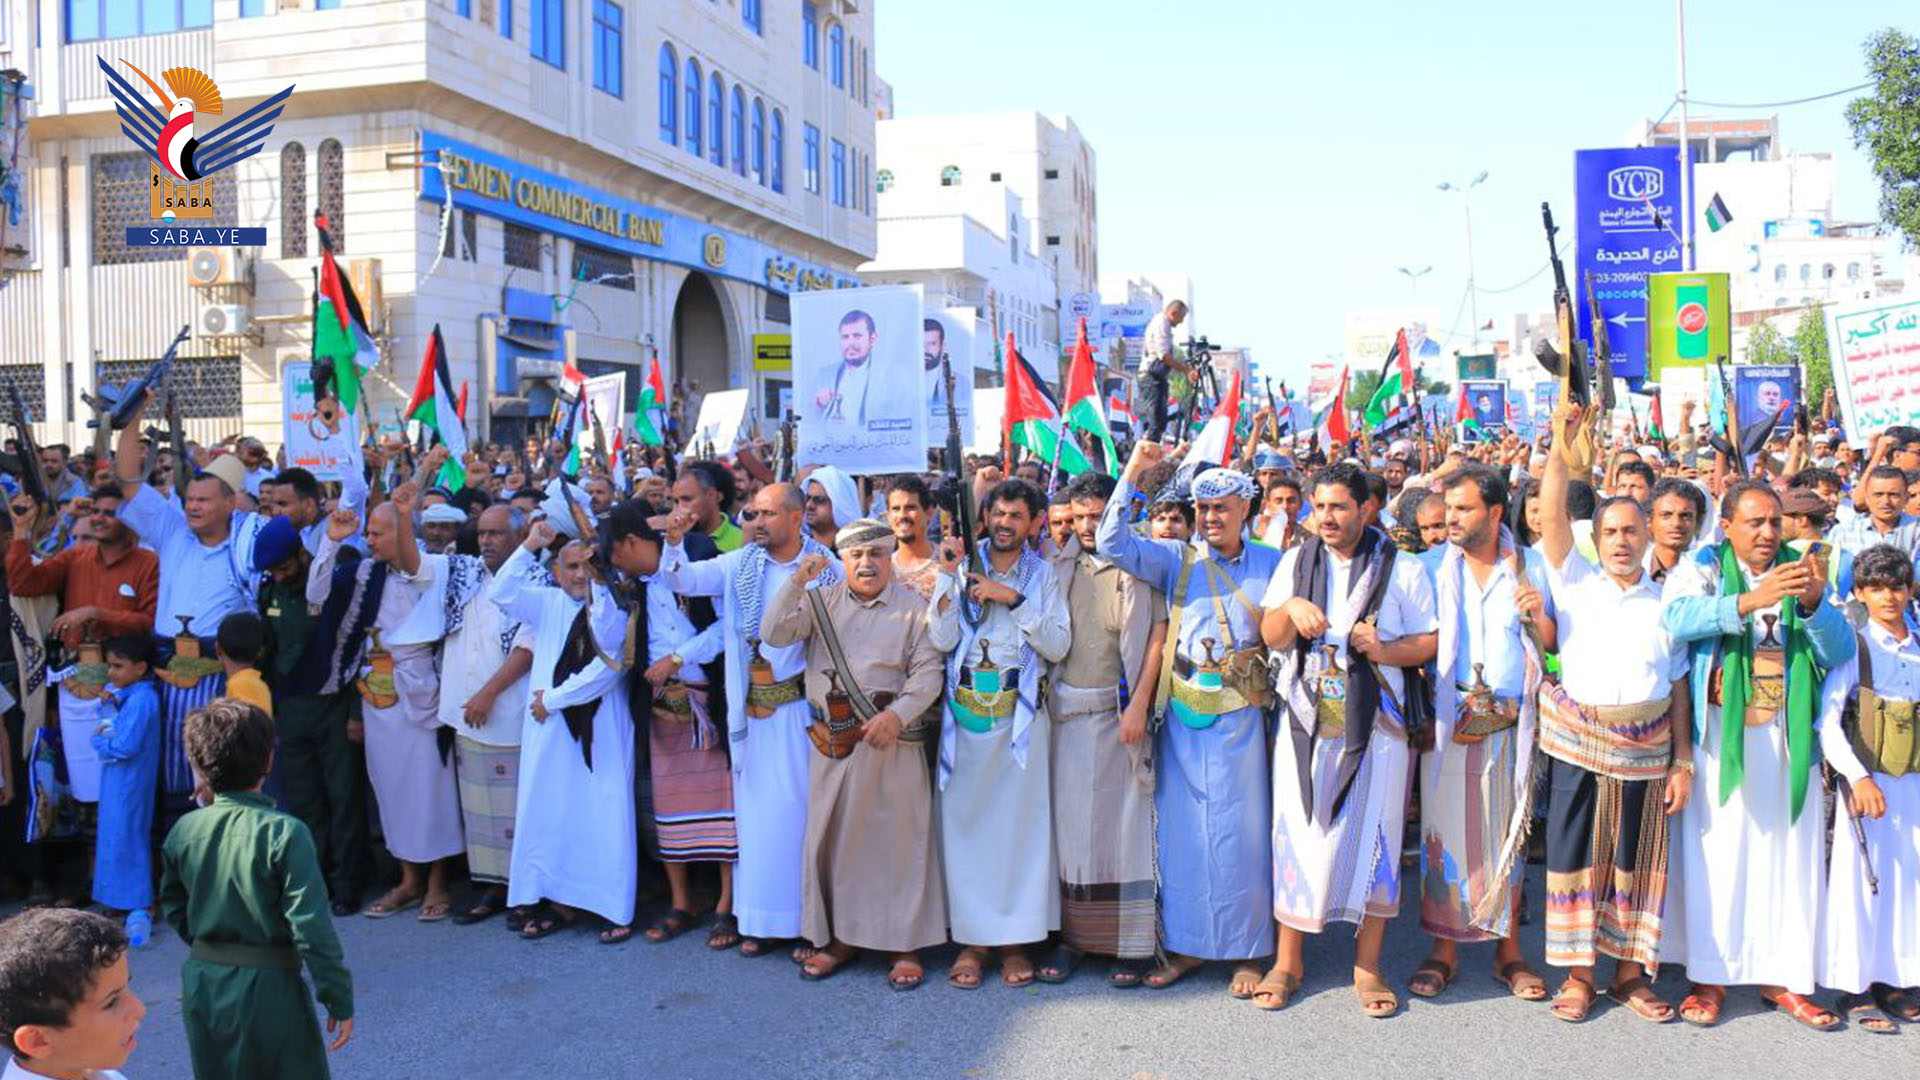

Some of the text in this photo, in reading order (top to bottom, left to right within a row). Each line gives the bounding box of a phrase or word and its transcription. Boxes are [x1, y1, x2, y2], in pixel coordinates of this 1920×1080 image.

[1613, 170, 1659, 197] YCB
[516, 178, 625, 239] COMMERCIAL
[629, 210, 665, 247] BANK
[1596, 247, 1680, 265] فرع الحديدة
[1895, 311, 1918, 330] لله
